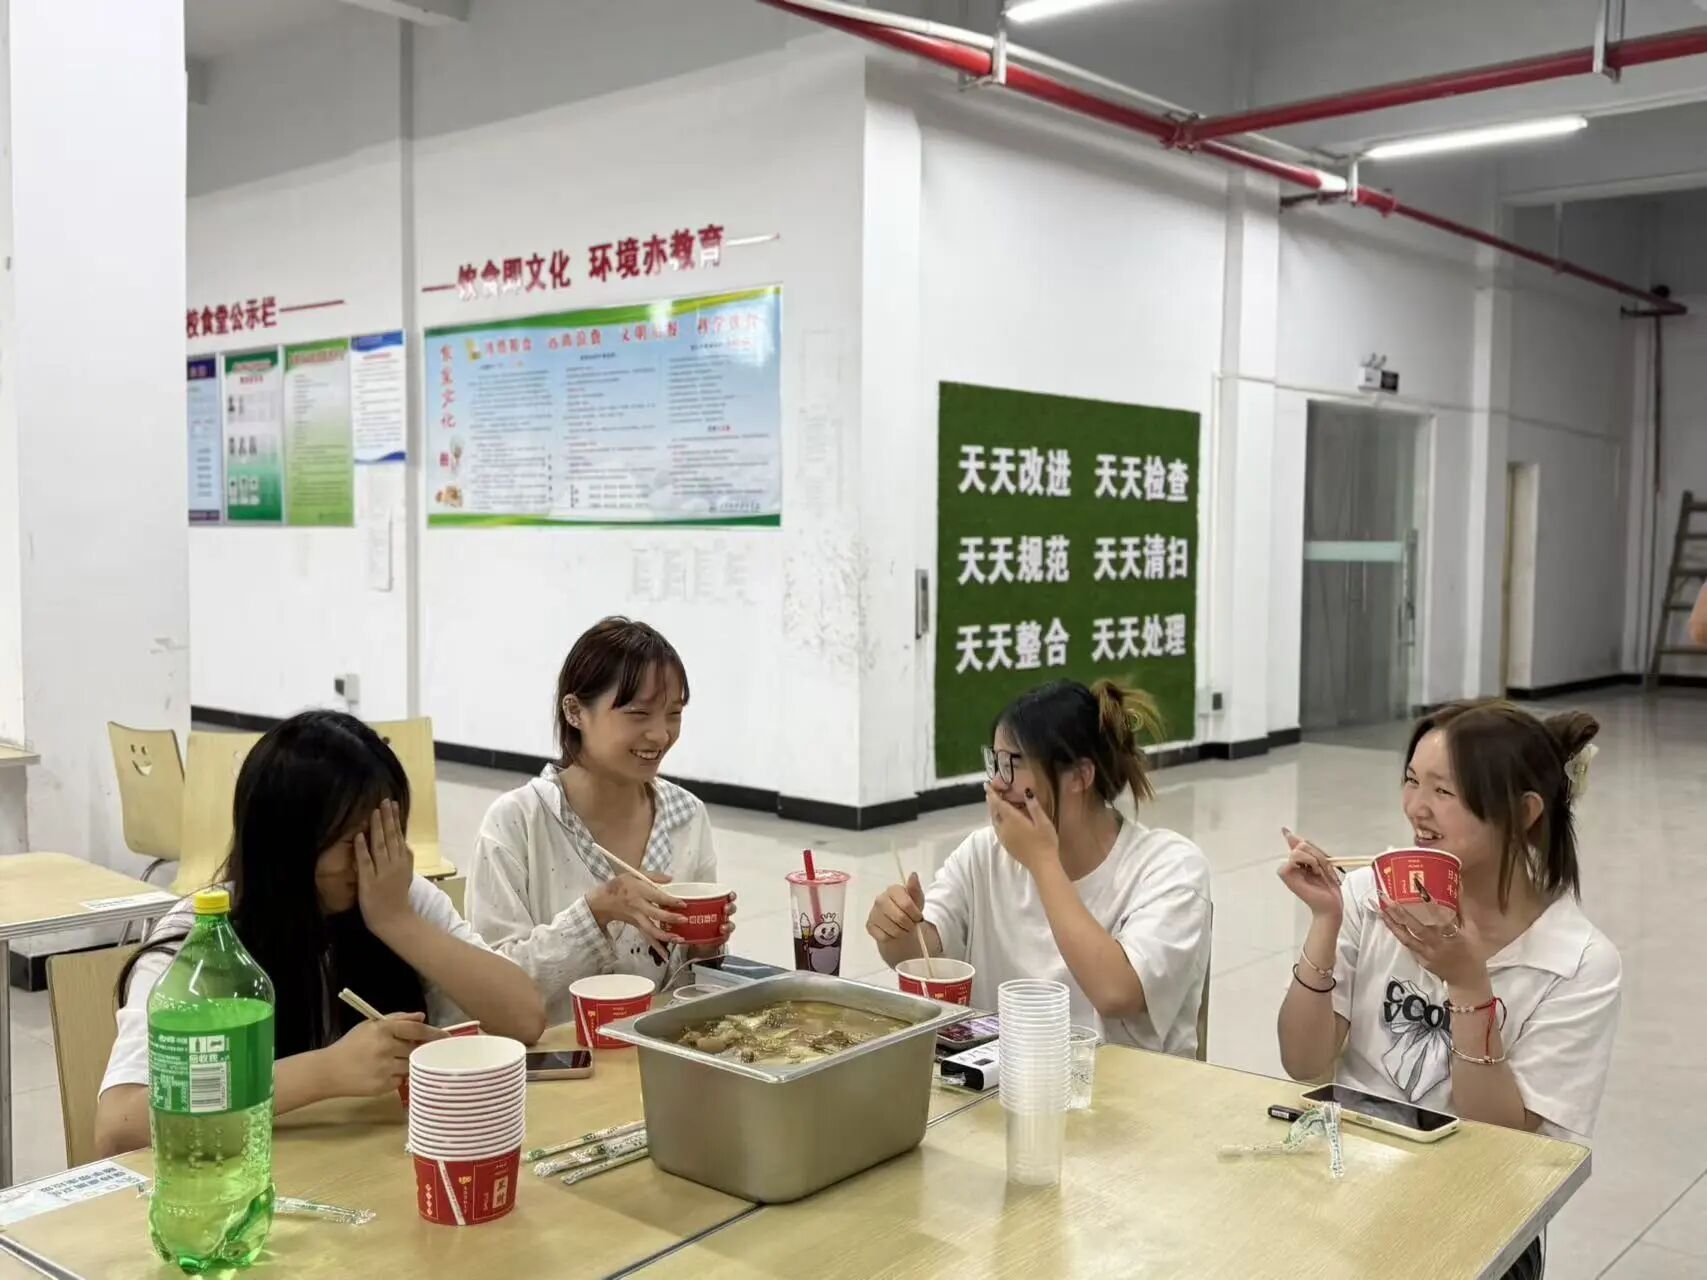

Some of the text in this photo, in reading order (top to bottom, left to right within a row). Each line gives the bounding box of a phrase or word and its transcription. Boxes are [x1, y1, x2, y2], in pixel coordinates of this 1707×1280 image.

[457, 224, 725, 300] 饮食即文化 环境亦教育
[958, 445, 1189, 501] 天天改进 天天检查
[958, 534, 1188, 585] 天天规范 天天清扫
[956, 614, 1187, 674] 天天整合 天天处理
